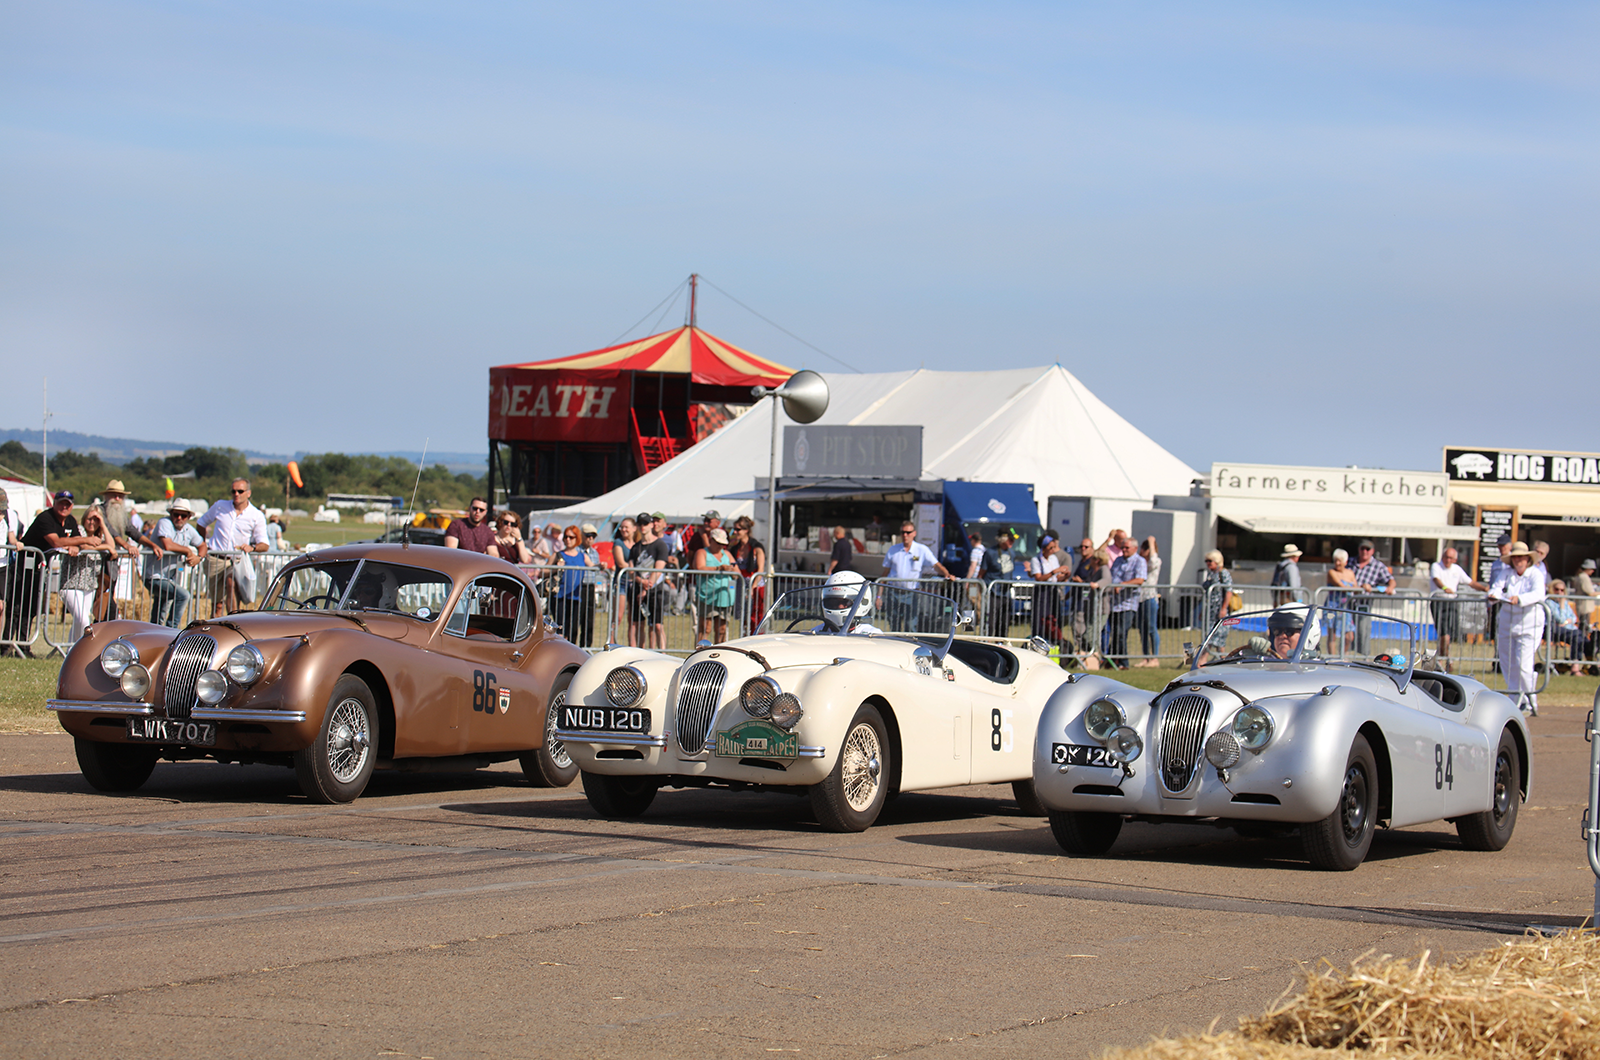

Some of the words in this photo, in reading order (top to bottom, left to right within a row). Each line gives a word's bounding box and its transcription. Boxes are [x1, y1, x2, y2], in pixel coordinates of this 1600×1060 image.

[822, 435, 852, 466] PIT
[857, 435, 908, 467] STOP
[1216, 468, 1328, 493] farmers
[1343, 474, 1445, 498] kitchen
[1497, 453, 1545, 481] HOG
[1551, 456, 1600, 484] ROA
[473, 669, 497, 715] 86
[131, 719, 168, 740] LWK
[173, 722, 211, 742] 707
[565, 708, 605, 729] NUB
[609, 710, 643, 730] 120
[991, 708, 1014, 753] 85
[718, 734, 745, 755] RALLYE
[769, 736, 795, 757] ALPES
[748, 740, 763, 749] 414
[1435, 743, 1453, 790] 84
